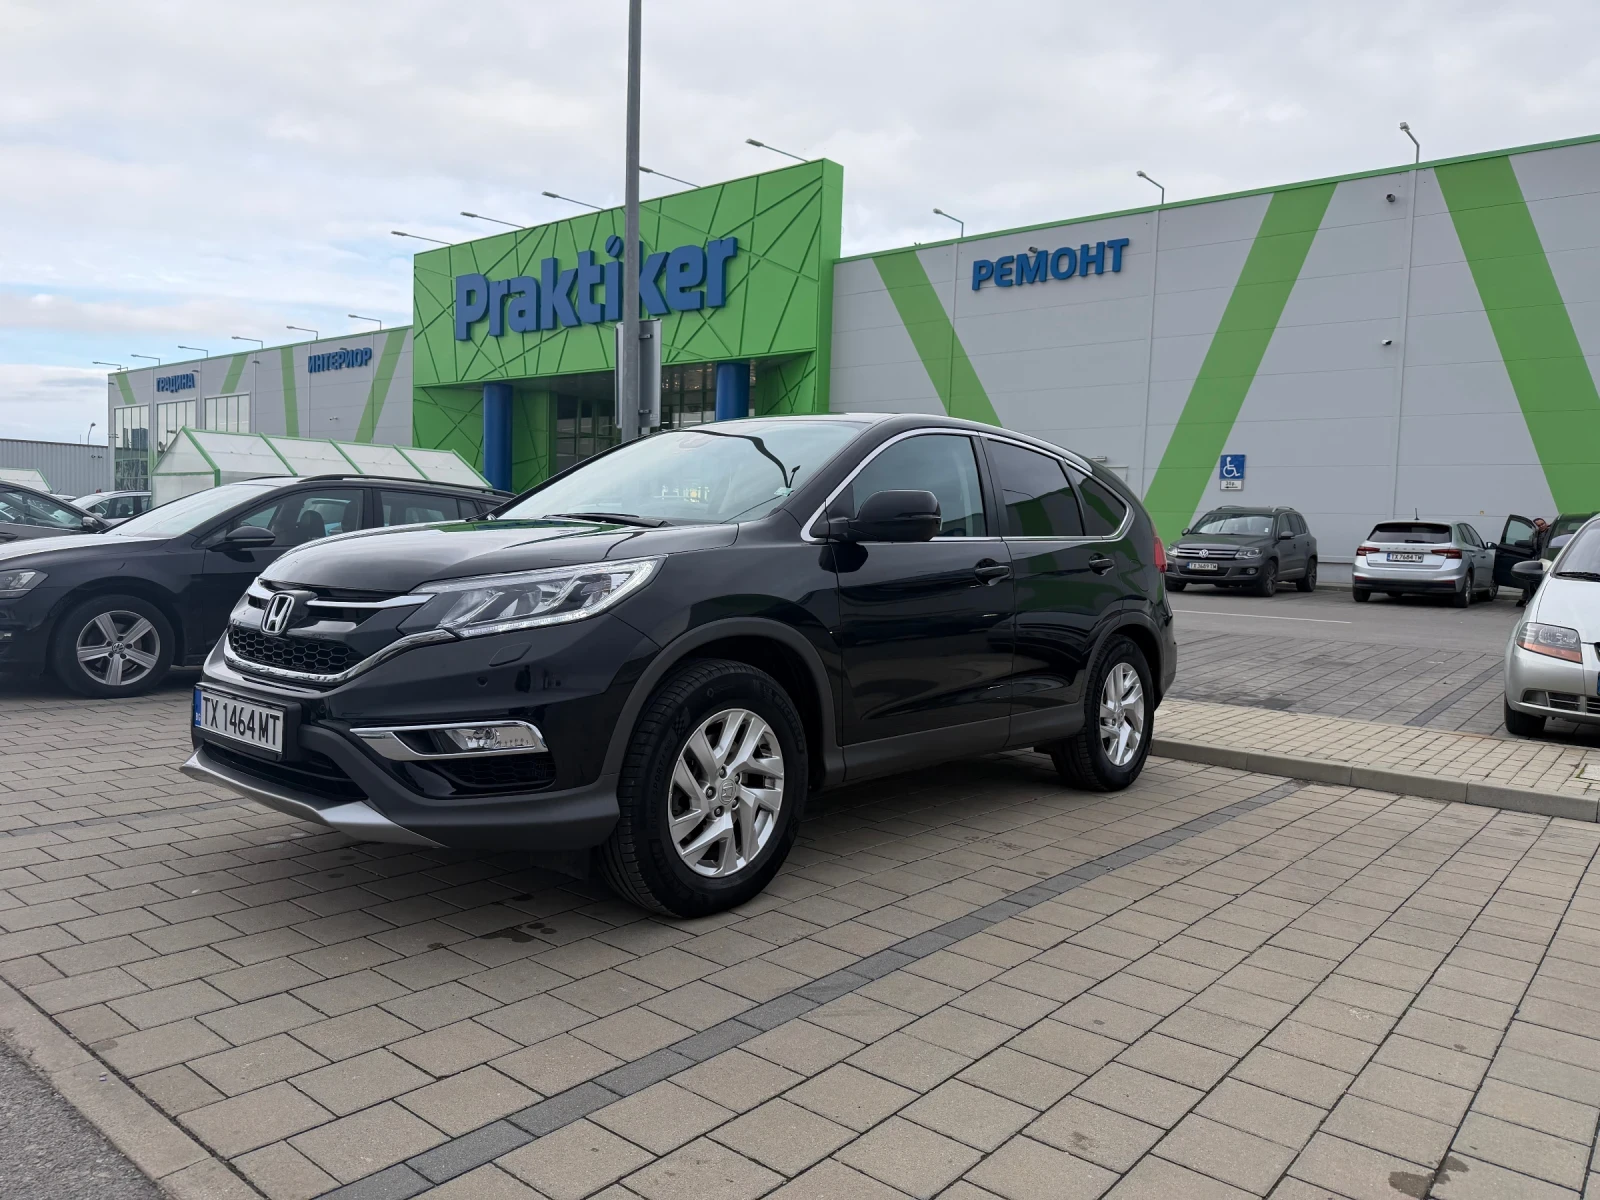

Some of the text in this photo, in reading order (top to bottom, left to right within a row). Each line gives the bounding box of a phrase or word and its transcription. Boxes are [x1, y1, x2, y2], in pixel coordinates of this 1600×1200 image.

[455, 235, 738, 341] Praktiker
[972, 238, 1129, 291] РЕМОНТ
[156, 373, 195, 393] ГРАДИНА
[308, 347, 372, 374] ИНТЕРИОР
[202, 696, 280, 746] TX 1464 MT
